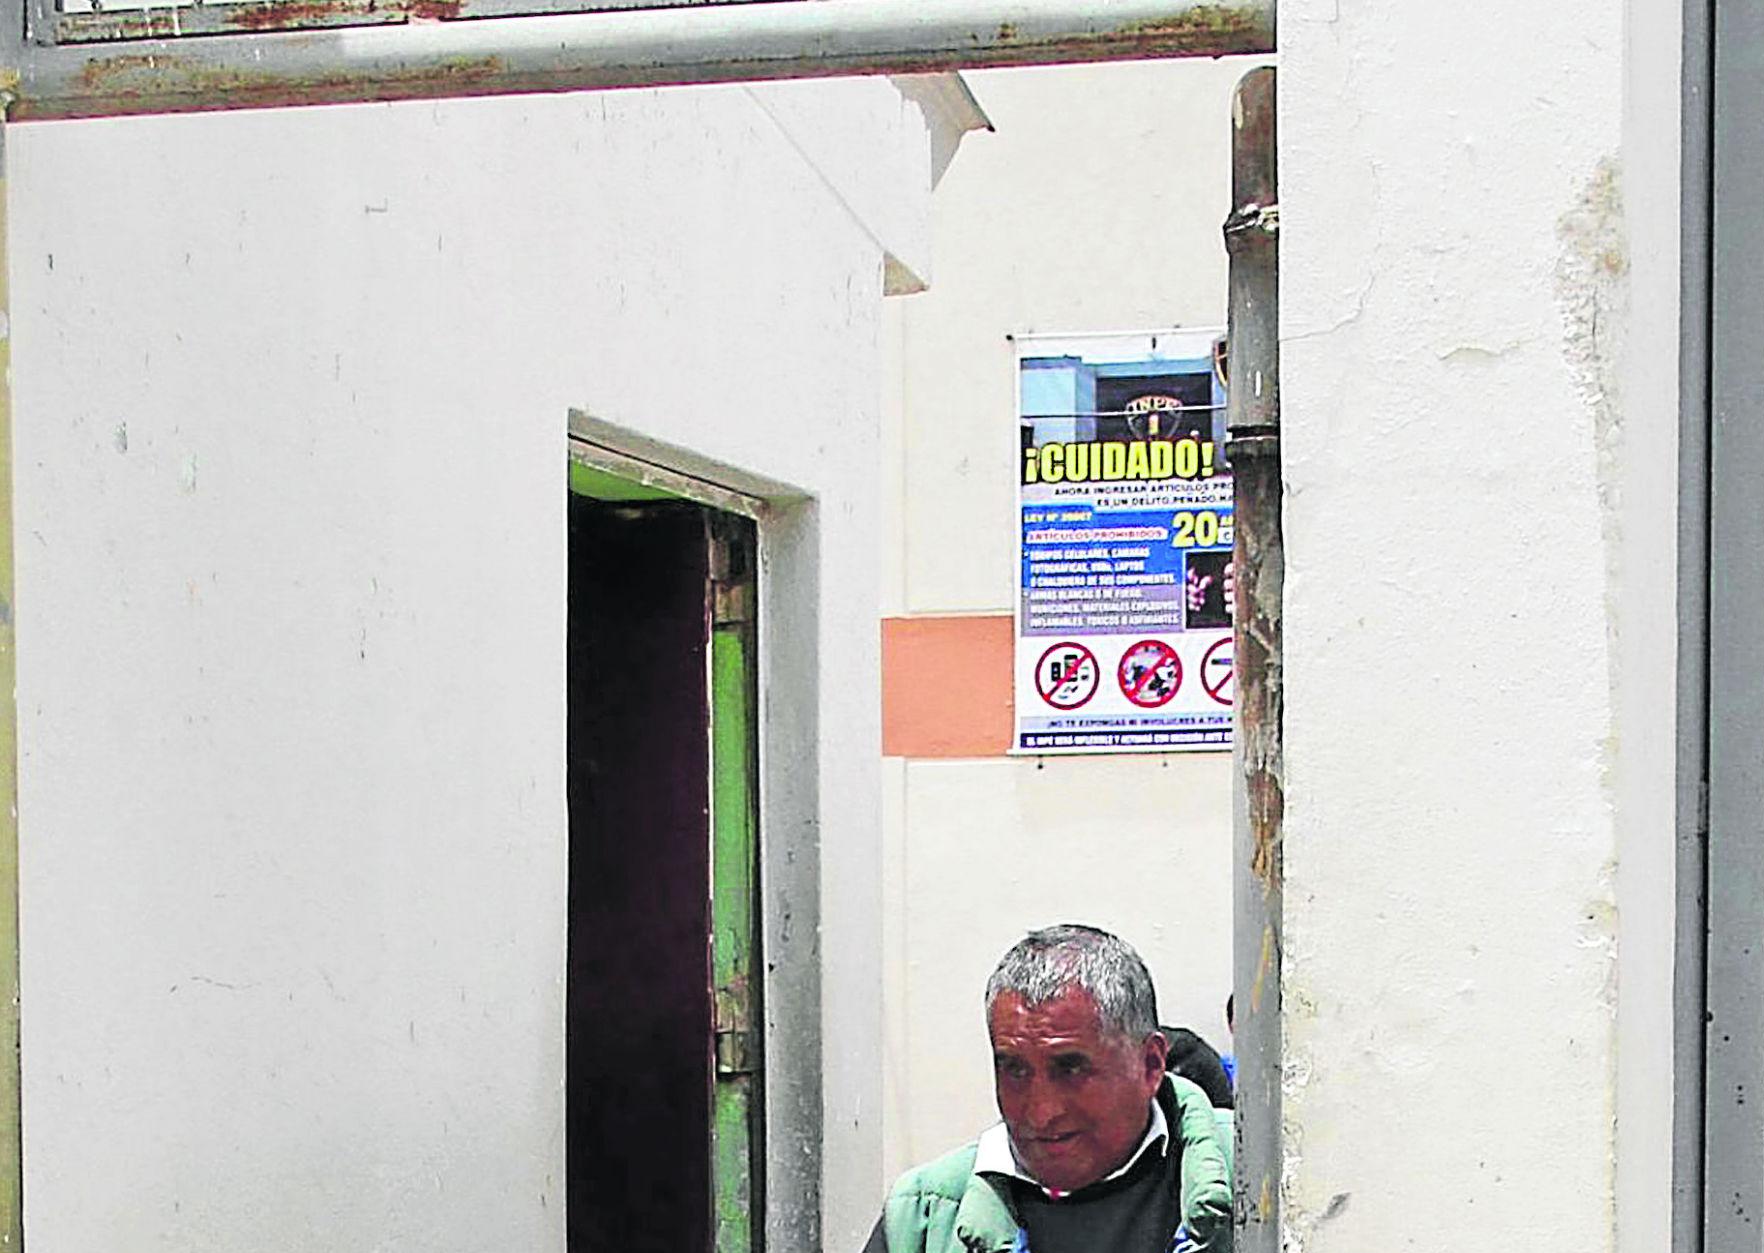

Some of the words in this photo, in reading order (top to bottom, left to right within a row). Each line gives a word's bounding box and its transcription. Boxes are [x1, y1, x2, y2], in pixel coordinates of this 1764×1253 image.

[1024, 438, 1215, 483] ¡CUIDADO!
[1093, 484, 1147, 495] INGRESAR
[1092, 529, 1163, 540] PROHIBIDOS
[1171, 510, 1219, 547] 20
